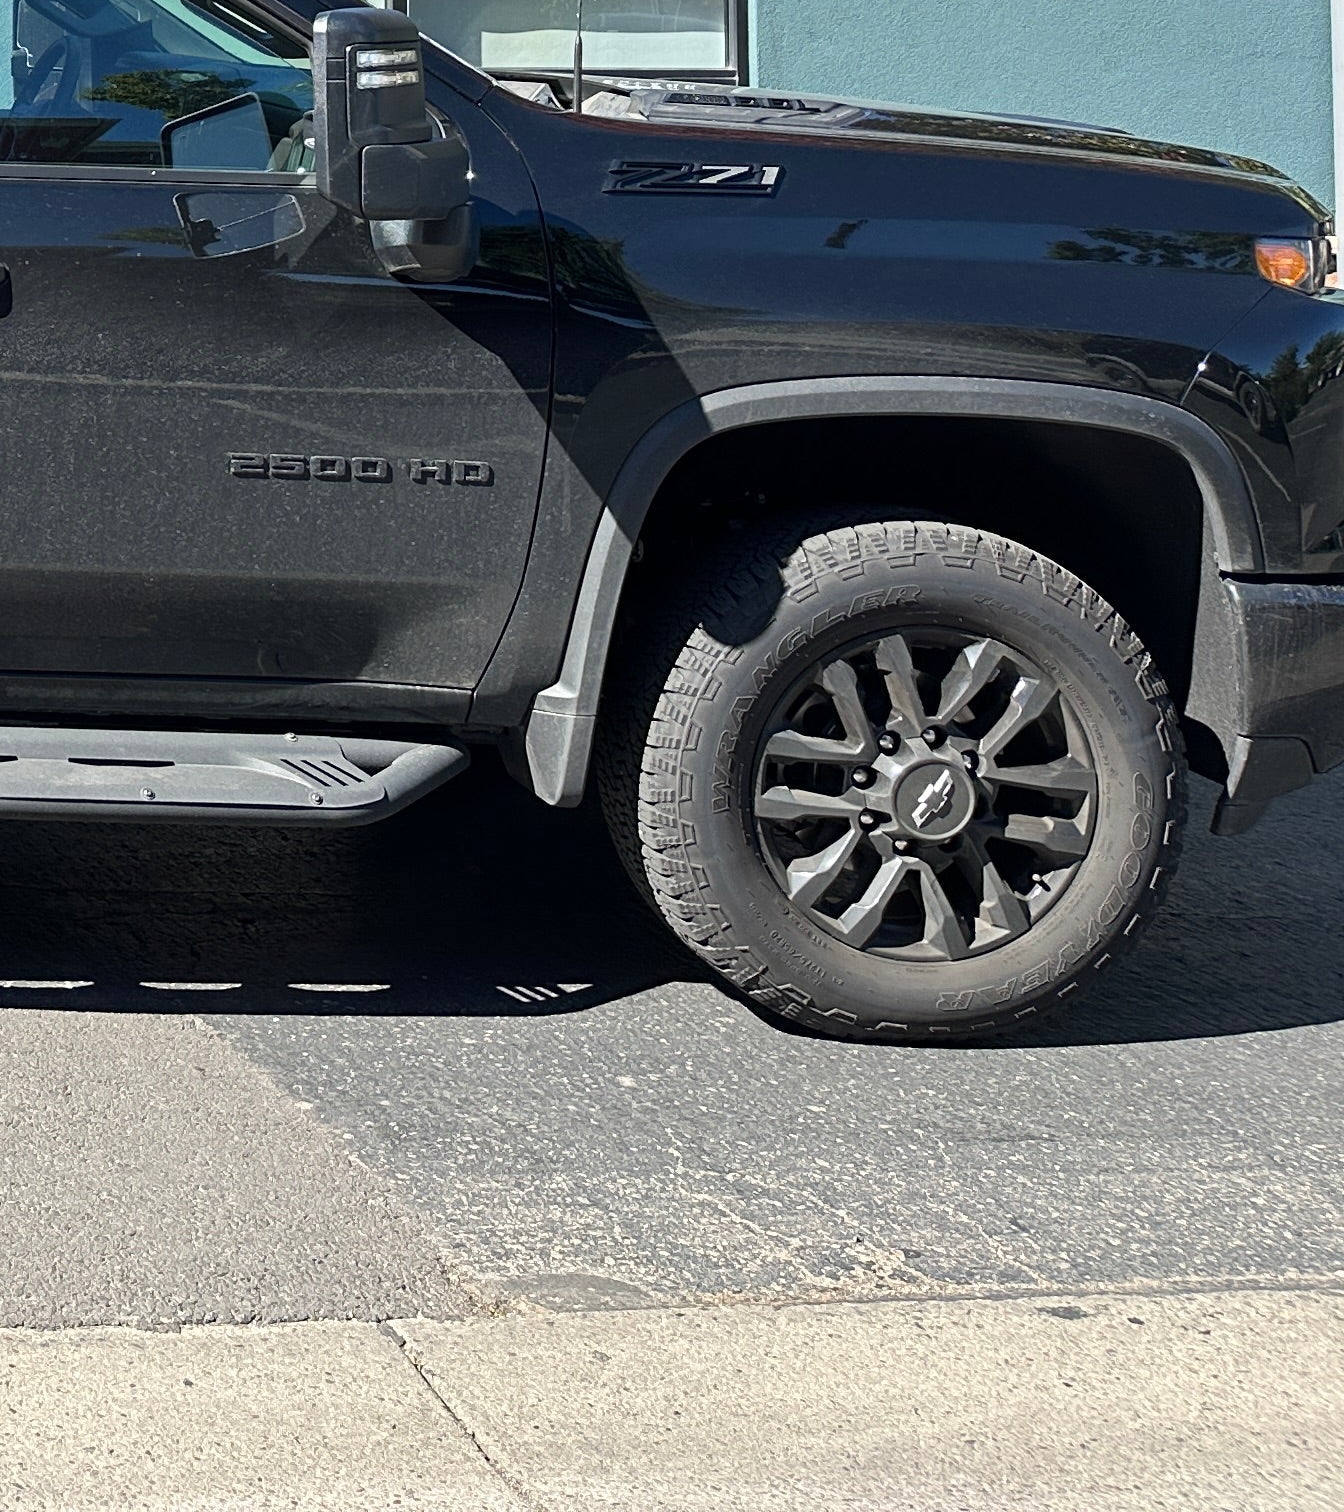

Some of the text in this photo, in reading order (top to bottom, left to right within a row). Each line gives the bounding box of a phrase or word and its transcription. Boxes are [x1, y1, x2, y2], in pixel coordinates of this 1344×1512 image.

[602, 159, 782, 196] Z71
[229, 452, 494, 485] 2500 HD
[712, 584, 922, 814] WRANGLER
[936, 771, 1155, 1011] GOODYEAR
